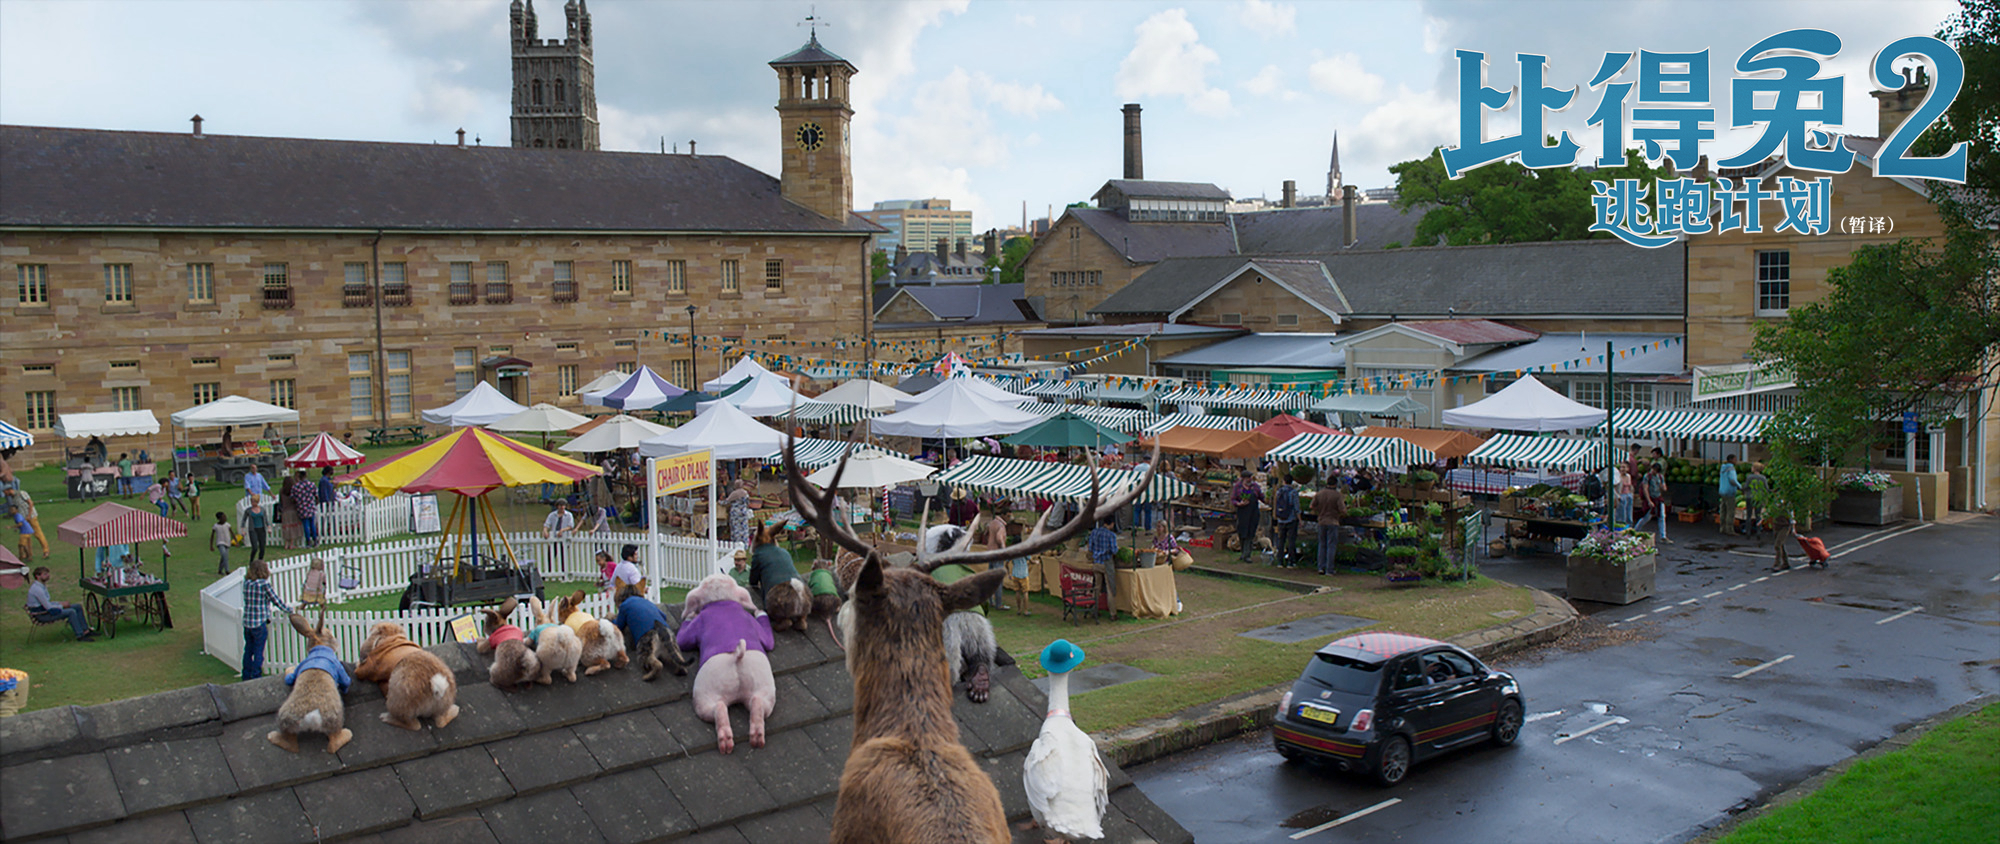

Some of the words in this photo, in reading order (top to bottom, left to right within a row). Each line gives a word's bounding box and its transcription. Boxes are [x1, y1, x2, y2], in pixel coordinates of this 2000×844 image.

[657, 466, 681, 490] CHAIR
[681, 464, 687, 481] O
[687, 460, 709, 480] PLANE
